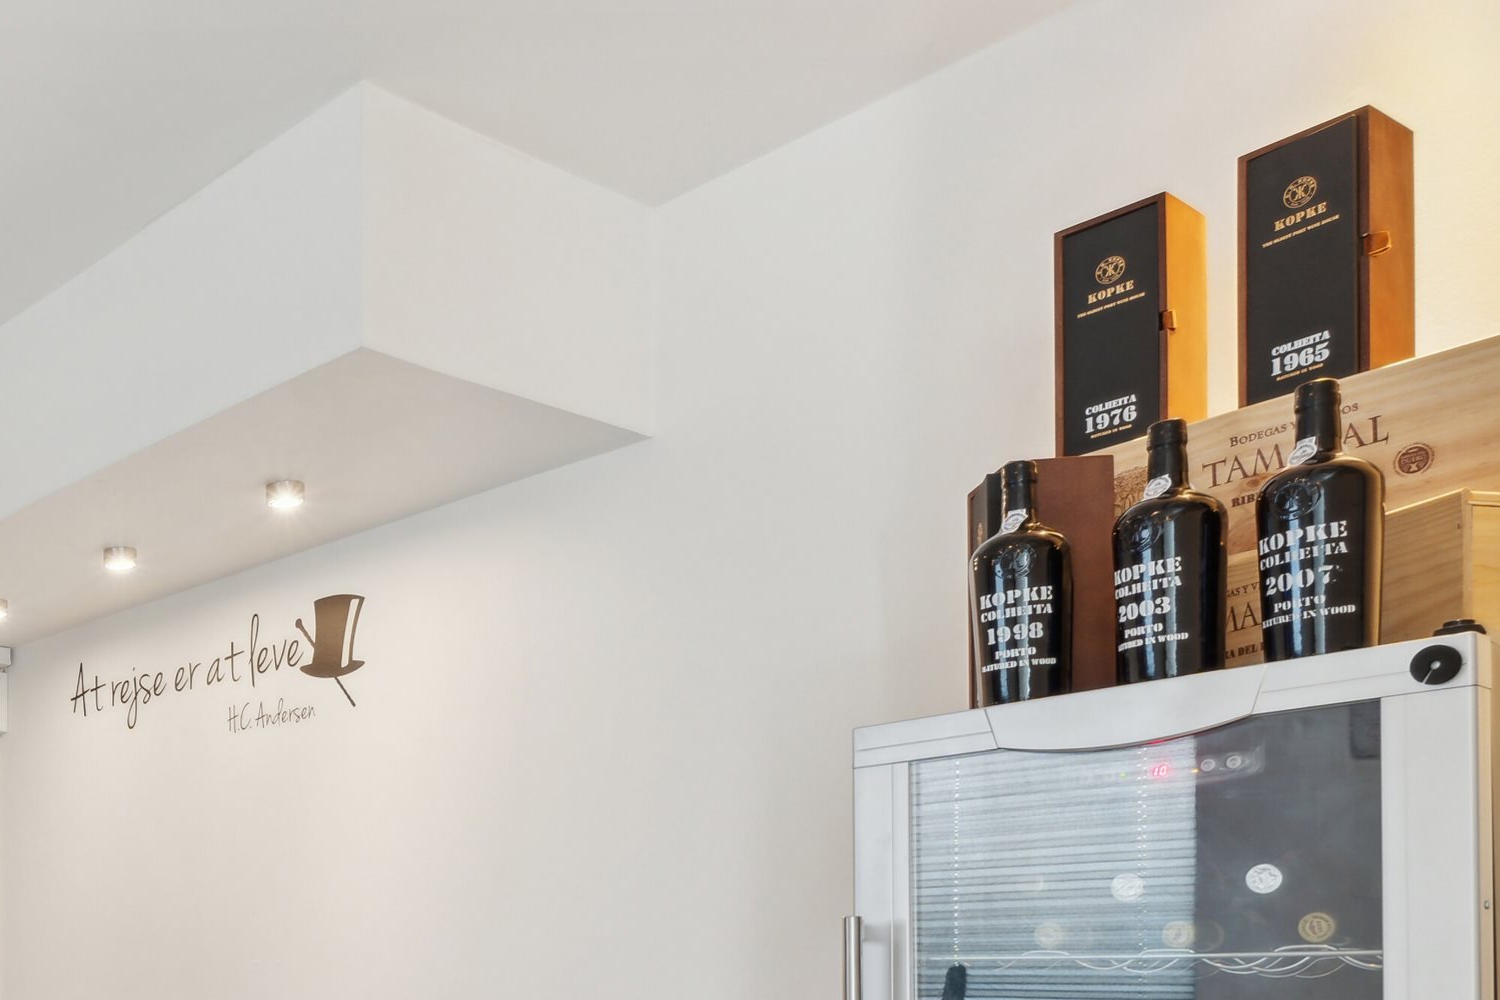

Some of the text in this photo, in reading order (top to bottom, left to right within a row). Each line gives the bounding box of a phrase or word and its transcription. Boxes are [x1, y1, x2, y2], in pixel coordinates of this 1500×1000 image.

[1274, 202, 1327, 232] KOPKE
[1088, 280, 1135, 304] KOPKE
[1271, 330, 1330, 356] COLHEITA
[1271, 341, 1330, 377] 1965
[1085, 394, 1137, 416] COLHEITA
[1085, 404, 1137, 434] 1976
[1258, 520, 1349, 556] KOPKE
[1259, 541, 1349, 571] COLHEITA
[1266, 564, 1335, 597] 2007
[980, 585, 1053, 610] KOPKE
[1118, 596, 1171, 623] 2003
[1274, 594, 1327, 613] PORTO
[980, 603, 1053, 623] COLHEITA
[1318, 604, 1357, 617] WOOD
[987, 622, 1044, 646] 1998
[1124, 622, 1164, 639] PORTO
[1157, 632, 1189, 643] WOOD
[994, 646, 1037, 660] PORTO
[1031, 657, 1057, 666] WOOD
[70, 613, 304, 729] At rejse er at leve
[255, 698, 316, 729] Andersen
